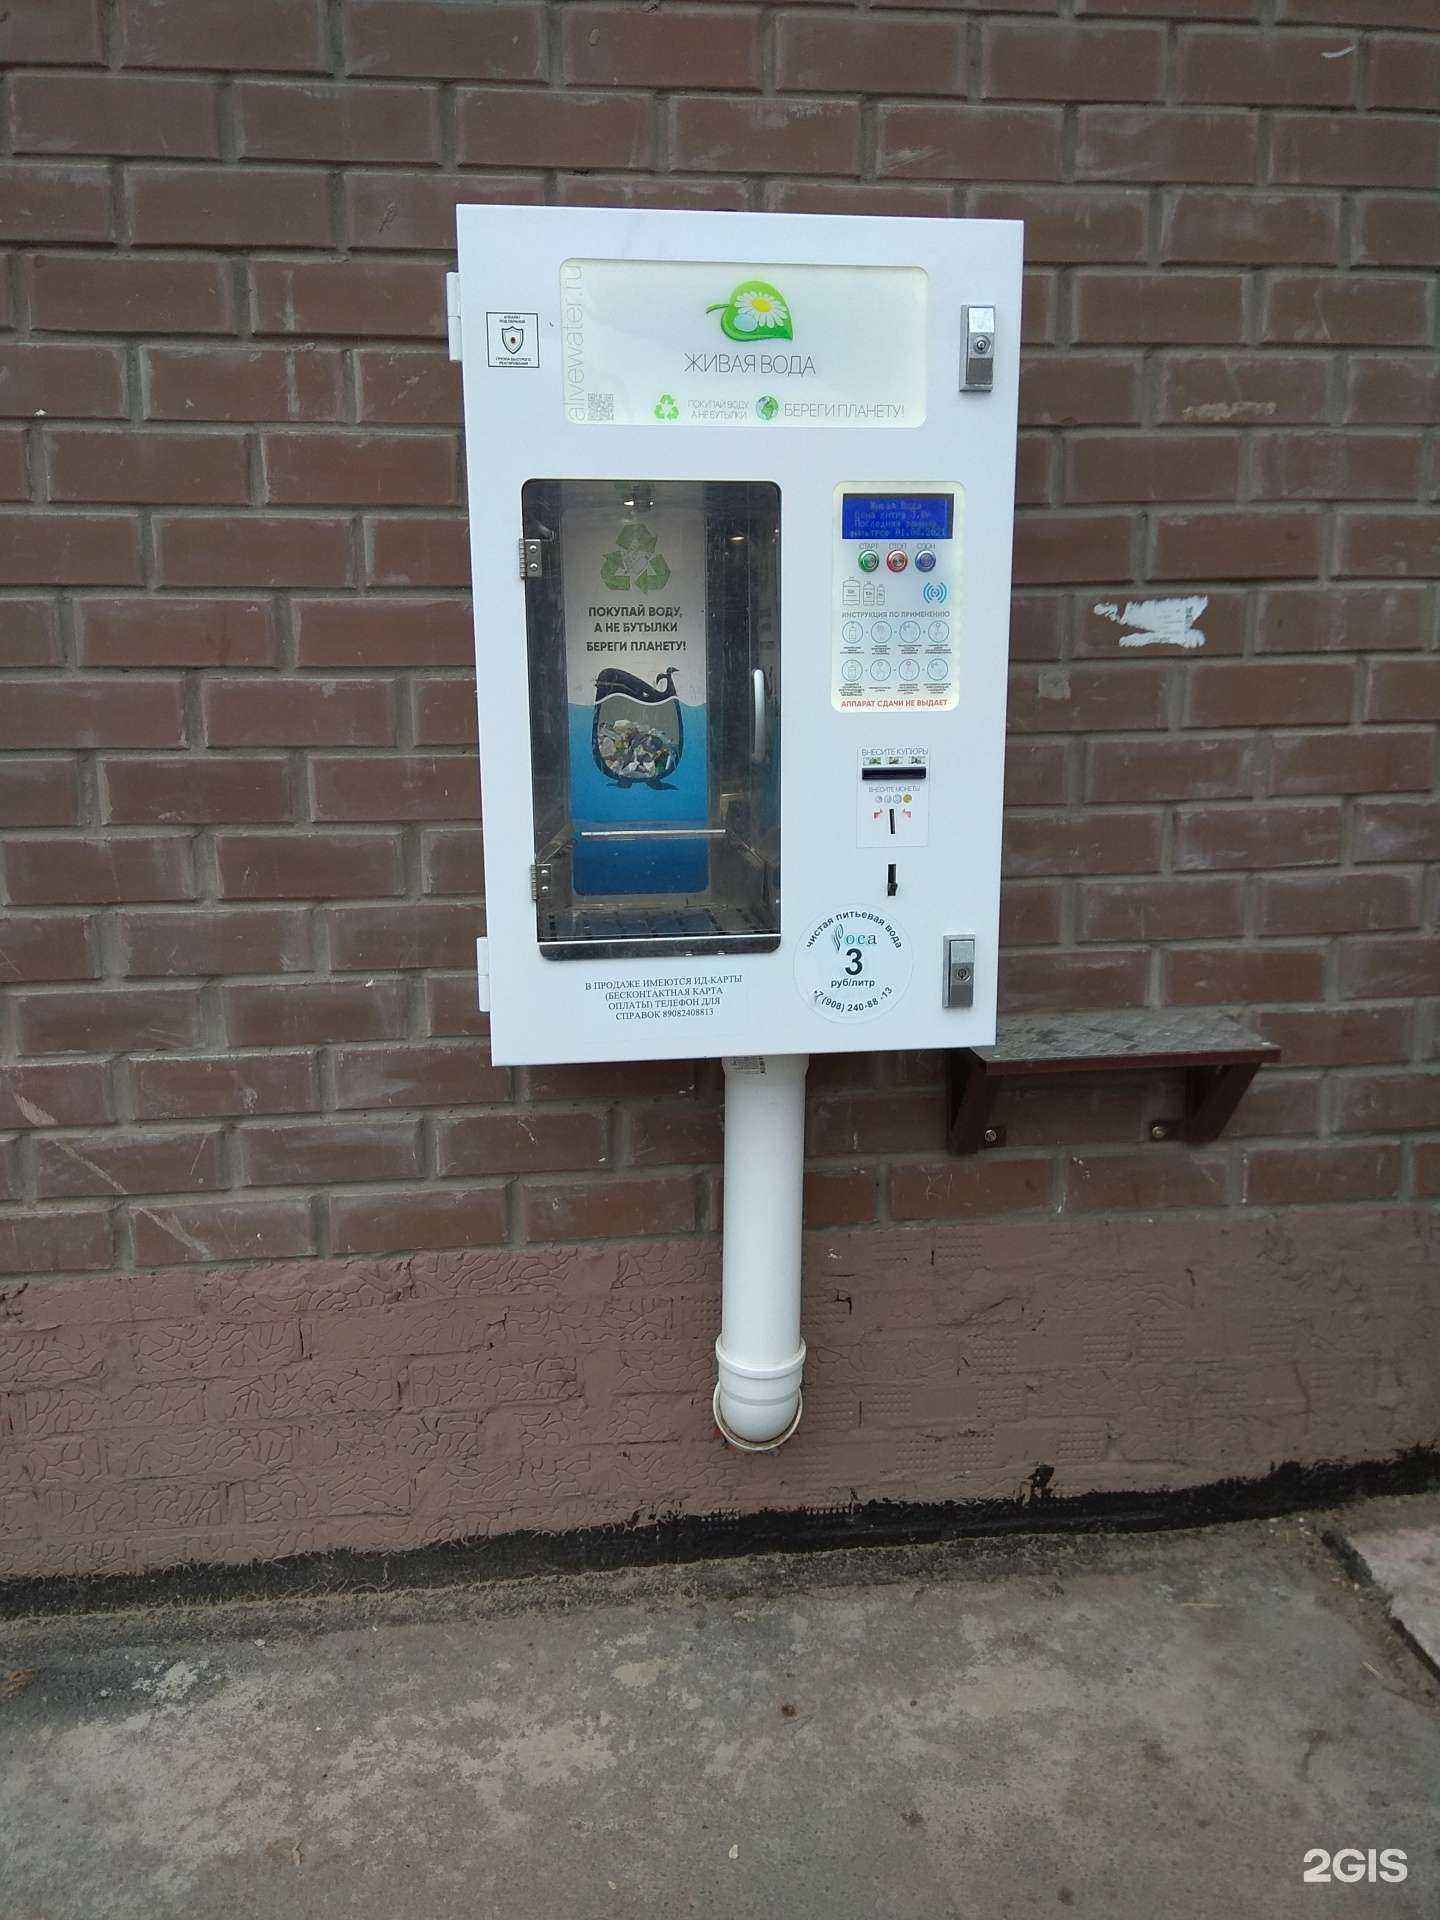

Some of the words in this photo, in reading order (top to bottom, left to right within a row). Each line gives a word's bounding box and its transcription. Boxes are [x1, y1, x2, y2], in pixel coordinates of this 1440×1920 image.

[684, 352, 756, 374] ЖИВАЯ
[760, 354, 817, 376] ВОДА
[784, 402, 835, 418] БЕРЕГИ
[838, 403, 905, 419] ПЛАНЕТУ!
[588, 604, 646, 617] ПОКУПАЙ
[648, 606, 682, 618] ВОДУ,
[841, 611, 888, 619] ИНСТРУКЦИЯ
[888, 611, 900, 619] ПО
[901, 610, 951, 618] ПРИМЕНЕНИЮ
[594, 622, 603, 633] А
[605, 622, 620, 633] НЕ
[623, 622, 678, 633] БУТЫЛКИ
[586, 641, 628, 652] БЕРЕГИ
[630, 640, 687, 651] ПЛАНЕТУ!
[841, 700, 876, 708] АППАРАТ
[877, 699, 904, 708] СДАЧИ
[905, 699, 915, 707] НЕ
[861, 748, 896, 757] ВНЕСИТЕ
[897, 747, 929, 756] КУПЮРЫ
[806, 917, 834, 948] чистая
[836, 910, 886, 926] питьевая
[885, 924, 902, 949] вода
[844, 947, 863, 976] 3
[585, 982, 592, 991] В
[594, 979, 641, 991] ПРОДАЖЕ
[643, 977, 692, 988] ИМЕЮТСЯ
[830, 978, 876, 988] руб/литр
[605, 989, 690, 1001] (БЕСКОНТАКТНАЯ
[692, 986, 724, 996] КАРТА
[608, 1001, 653, 1011] ОПЛАТЫ)
[655, 998, 699, 1008] ТЕЛЕФОН
[700, 997, 721, 1007] ДЛЯ
[821, 996, 846, 1013] (908)
[615, 1010, 661, 1021] СПРАВОК
[662, 1008, 714, 1018] 89082408813
